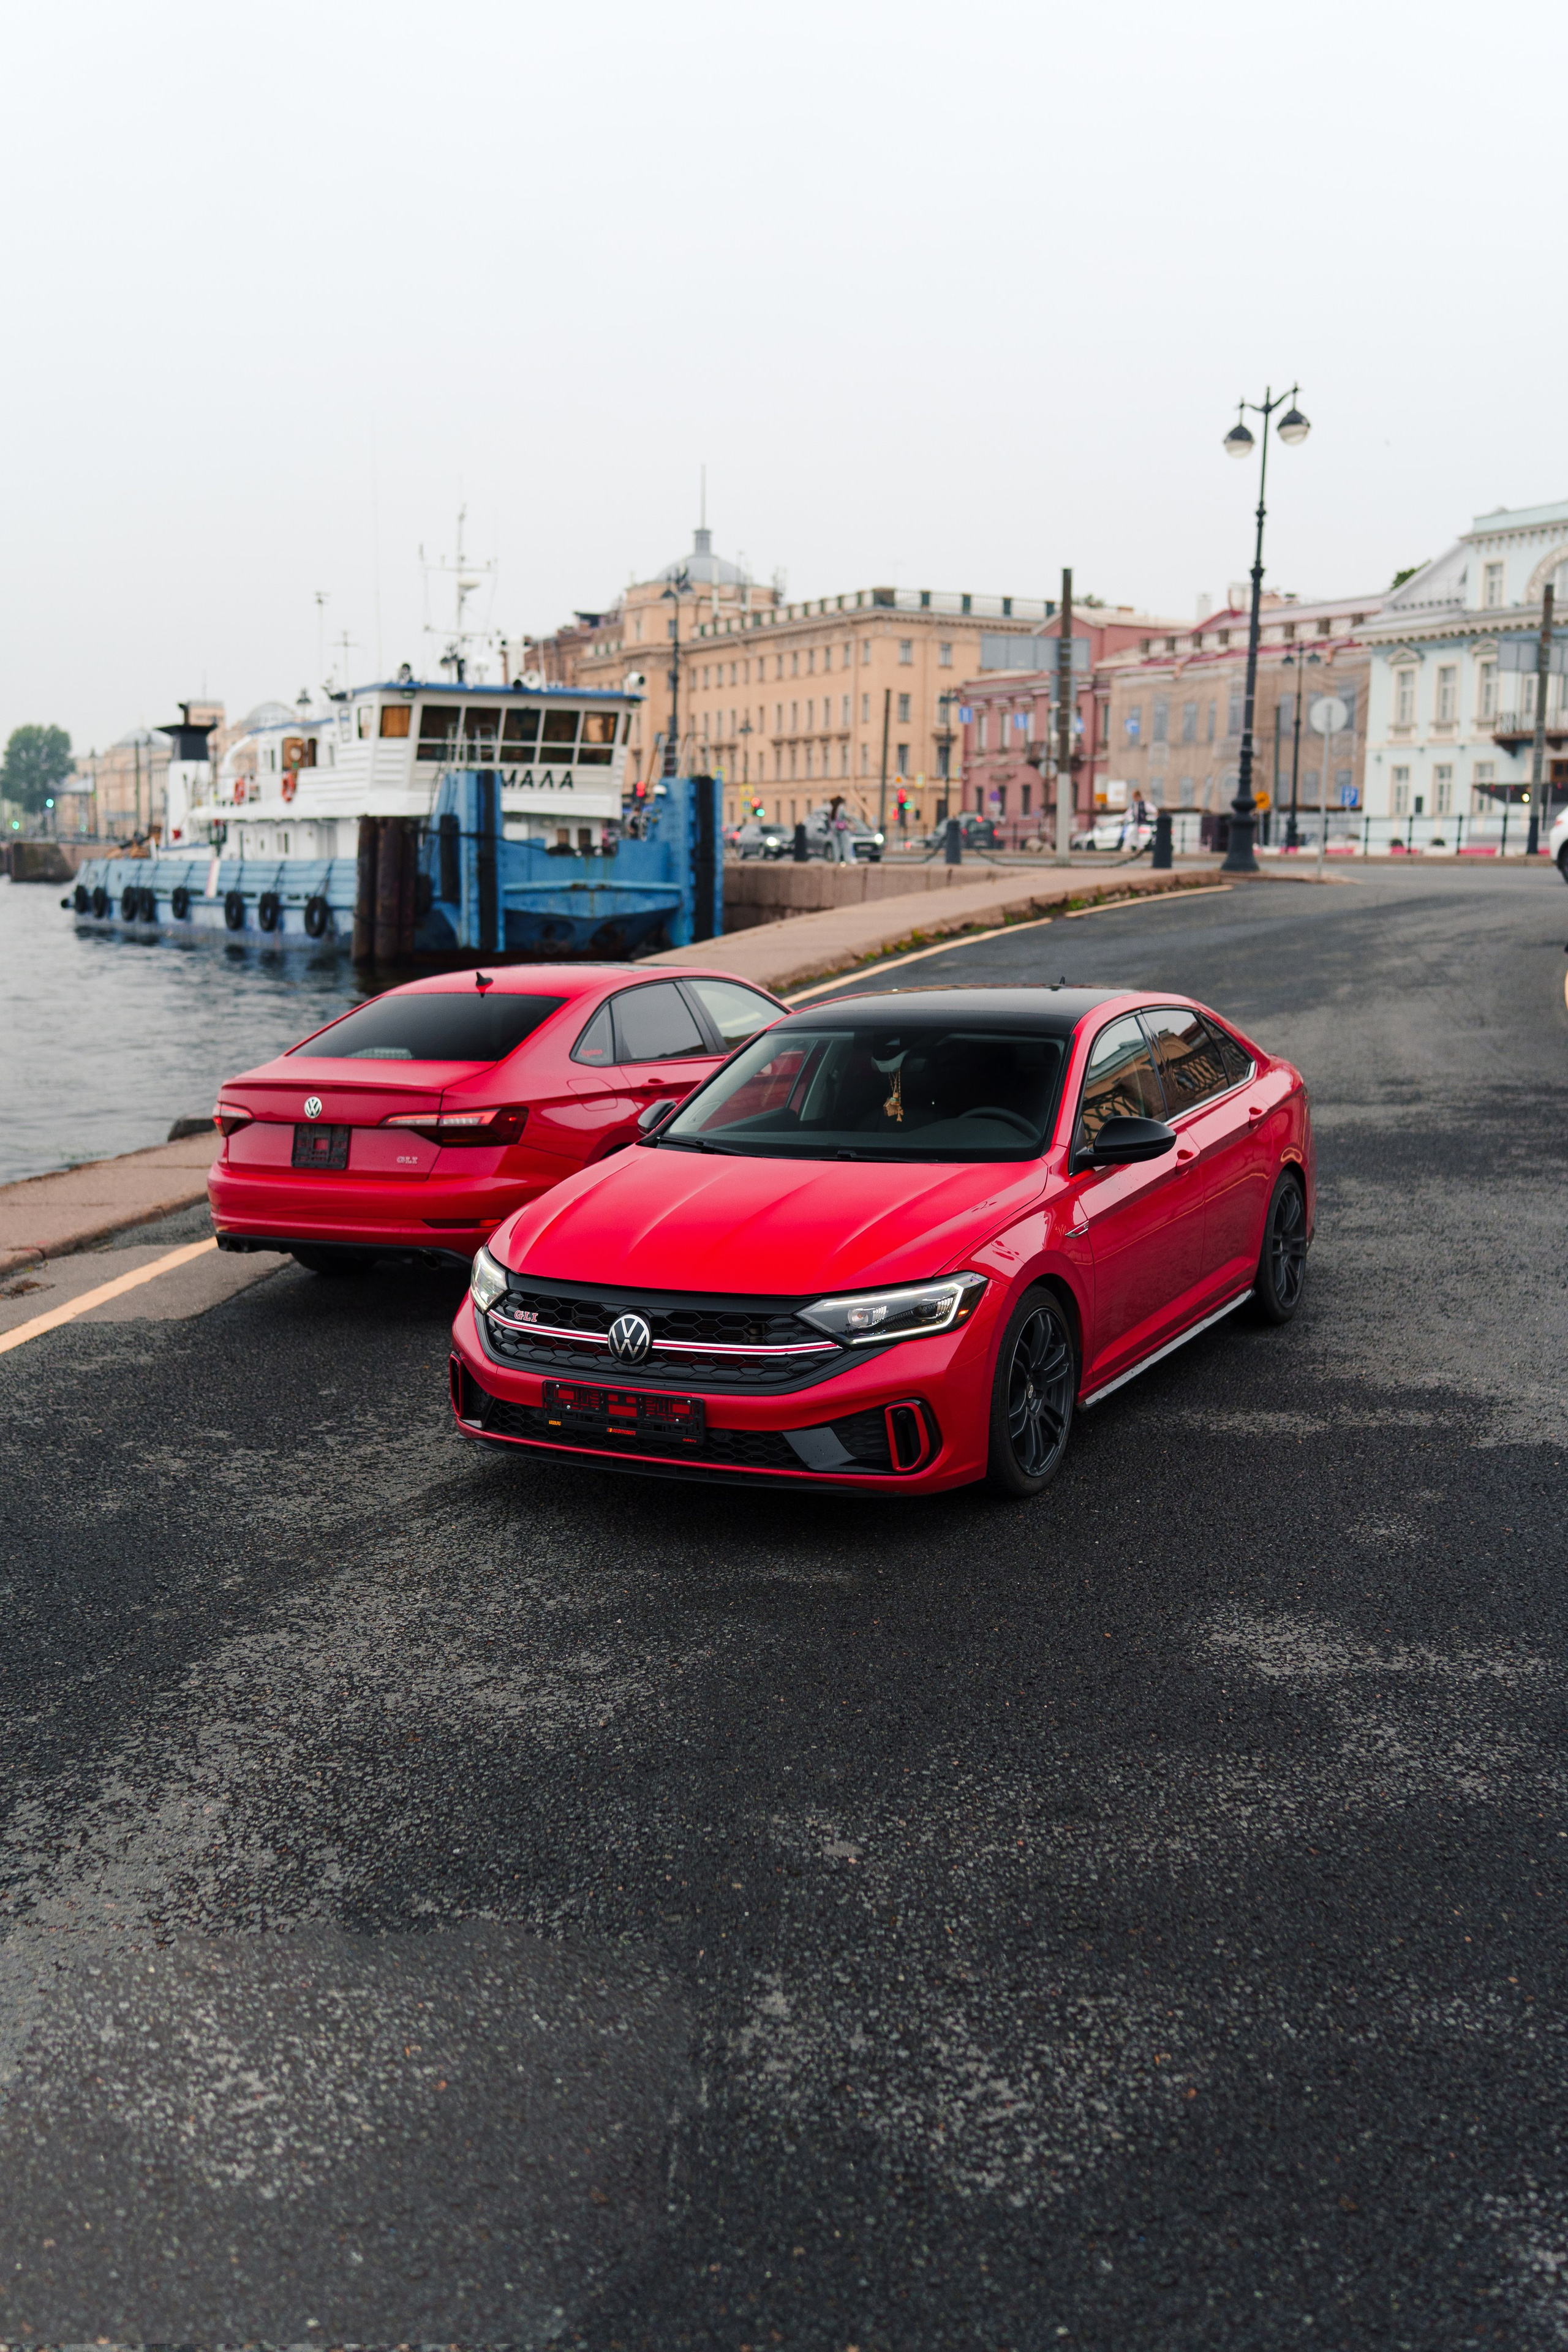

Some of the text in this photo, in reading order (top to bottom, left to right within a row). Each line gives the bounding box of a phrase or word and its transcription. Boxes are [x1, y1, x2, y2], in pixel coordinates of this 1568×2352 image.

[456, 769, 574, 789] МАЛА
[305, 1096, 322, 1118] VW
[397, 1156, 418, 1164] GLI
[514, 1310, 538, 1322] GLI
[609, 1315, 649, 1362] VW
